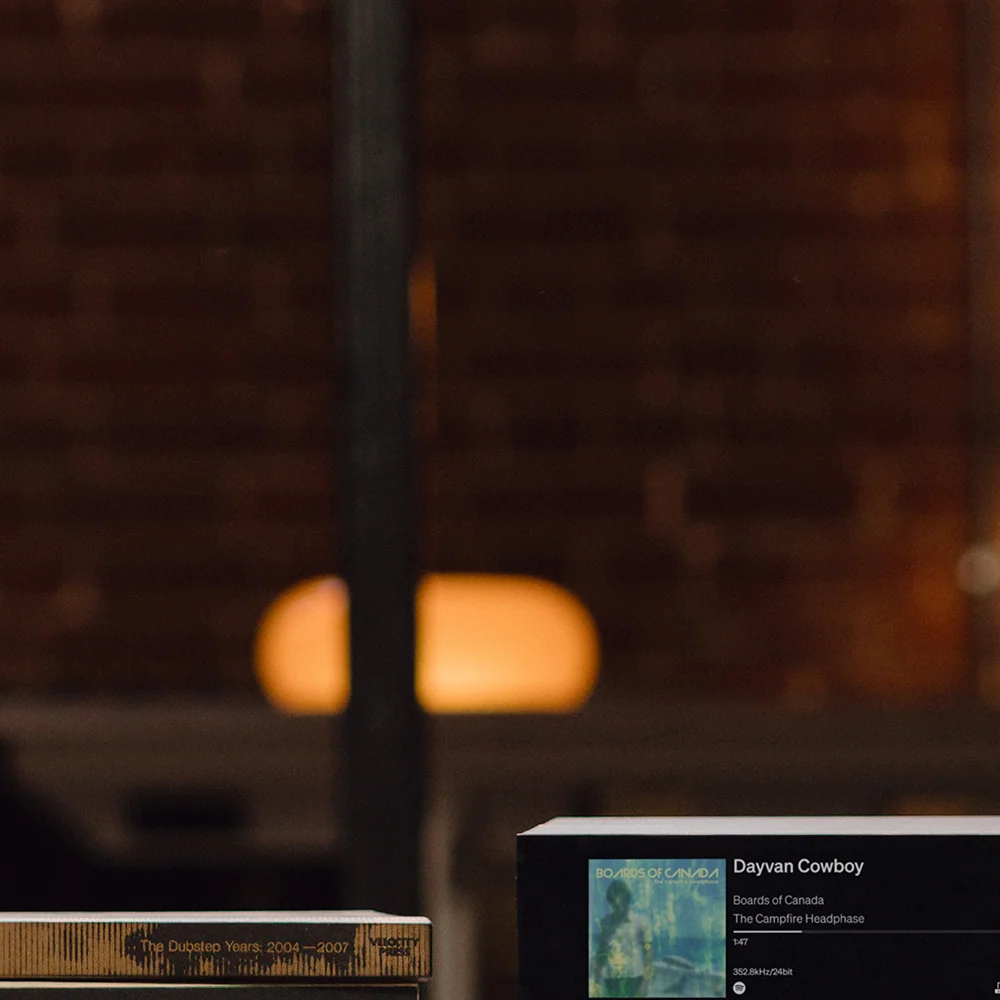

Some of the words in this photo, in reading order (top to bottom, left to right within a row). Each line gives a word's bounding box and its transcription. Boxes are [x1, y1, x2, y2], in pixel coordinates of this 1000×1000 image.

[595, 867, 645, 879] BOARDS
[647, 867, 663, 879] OF
[664, 867, 719, 879] CANADA
[733, 858, 794, 877] Dayvan
[797, 858, 865, 877] Cowboy
[733, 894, 770, 906] Boards
[771, 894, 783, 906] of
[784, 894, 825, 906] Canada
[733, 913, 754, 924] The
[755, 913, 803, 926] Campfire
[805, 913, 865, 926] Headphase
[140, 940, 165, 953] The
[168, 940, 221, 954] Dubstep
[266, 941, 300, 953] 2004
[733, 937, 749, 946] 1:47
[732, 967, 794, 977] 352.8kHz/24bit
